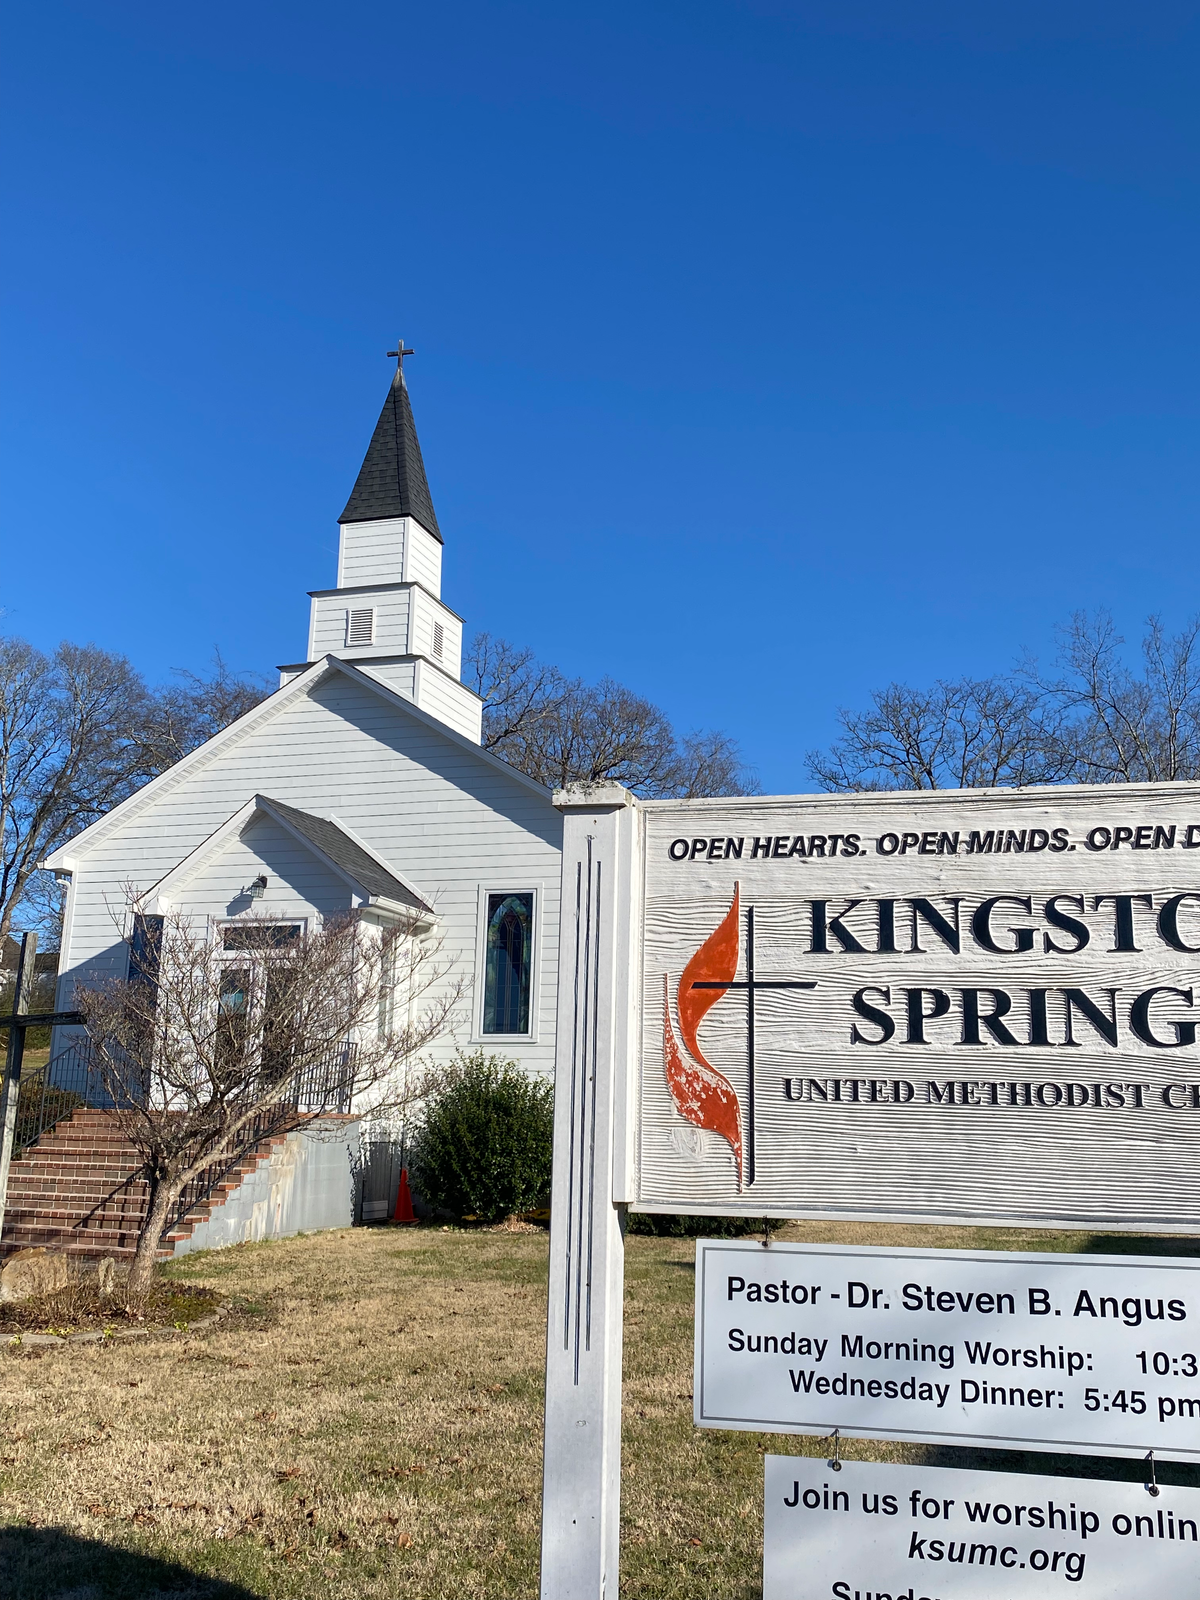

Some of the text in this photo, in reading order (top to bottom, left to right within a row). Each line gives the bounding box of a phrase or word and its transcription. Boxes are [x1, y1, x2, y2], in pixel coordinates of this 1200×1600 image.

[668, 837, 743, 861] OPEN
[751, 833, 867, 857] HEARTS.
[877, 830, 960, 856] OPEN
[969, 827, 1077, 854] MINDS.
[1088, 825, 1177, 850] OPEN
[851, 986, 1200, 1049] SPRING
[785, 1077, 915, 1103] UNITED
[926, 1080, 1150, 1108] METHODIST
[728, 1277, 822, 1305] Pastor
[848, 1282, 890, 1310] Dr.
[902, 1283, 1015, 1315] Steven
[1028, 1287, 1062, 1316] B.
[1073, 1290, 1187, 1327] Angus
[728, 1329, 1200, 1378] Sunday Morning Worship: 10:3
[789, 1370, 1200, 1423] Wednesday Dinner: 5:45 pm
[783, 1481, 1200, 1542] Join us for worship onlin
[908, 1532, 1086, 1582] ksumc.org
